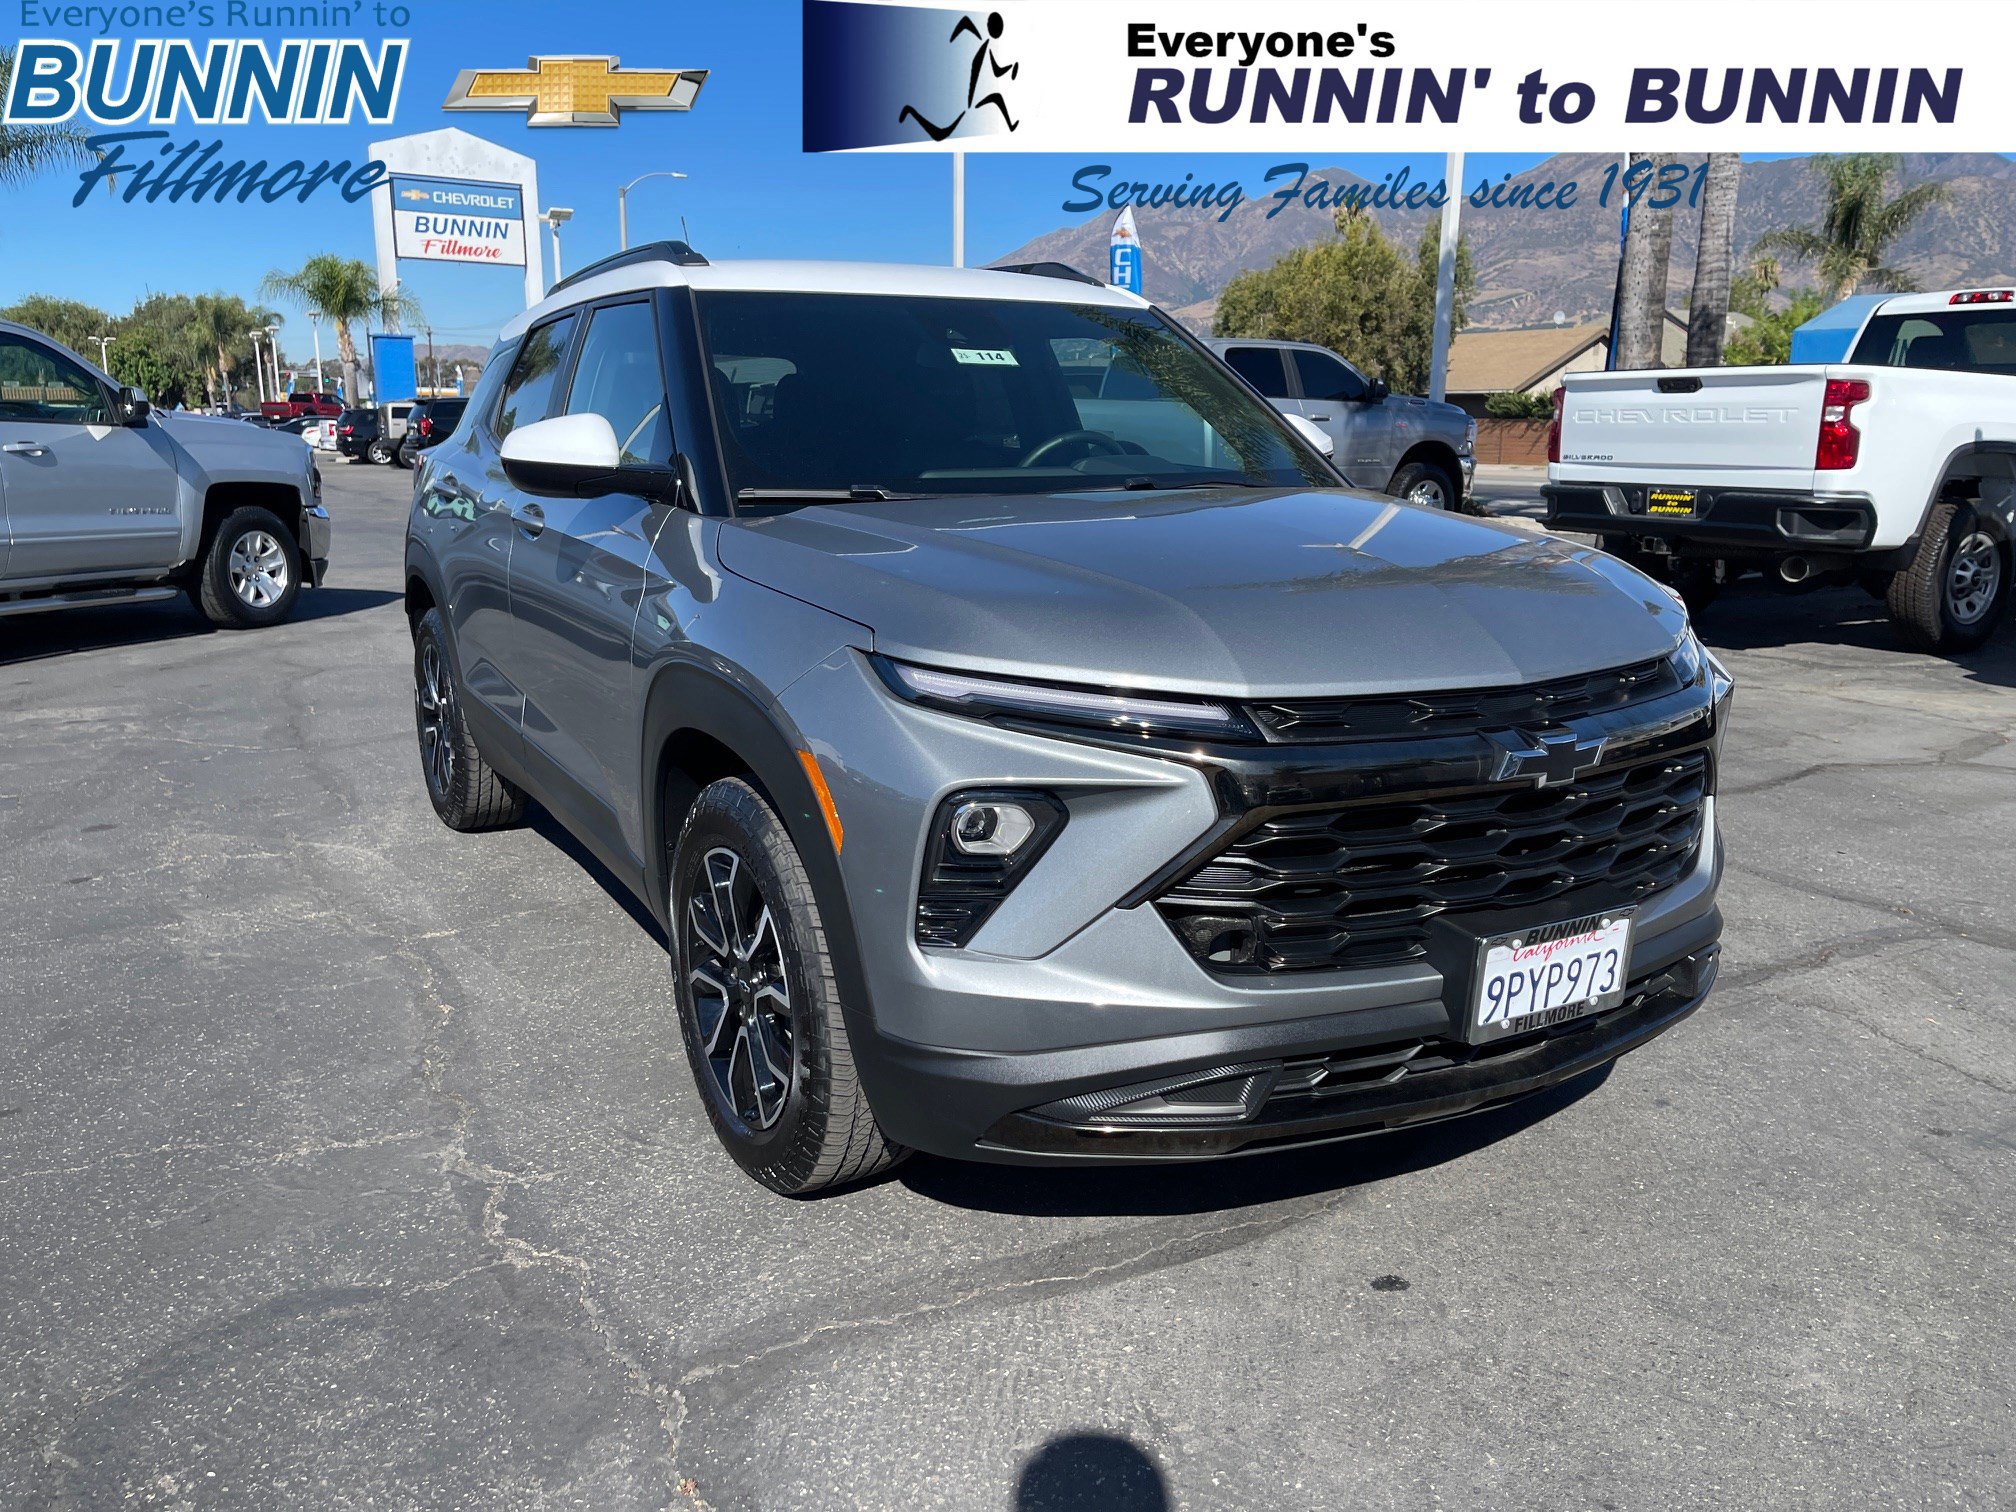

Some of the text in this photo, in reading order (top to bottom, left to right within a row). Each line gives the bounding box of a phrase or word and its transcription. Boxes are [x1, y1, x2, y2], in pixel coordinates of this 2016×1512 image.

[432, 190, 515, 210] CHEVROLET
[414, 215, 509, 240] BUNNIN
[421, 238, 502, 259] Fillmore
[1113, 248, 1132, 289] CH
[976, 352, 1005, 362] 114
[1574, 406, 1799, 425] CHEVROLET
[1650, 505, 1692, 514] BUNNIN
[1524, 913, 1603, 947] BUNNIN
[1483, 948, 1619, 1025] 9PYP973
[1514, 1001, 1585, 1033] FILLMORE
